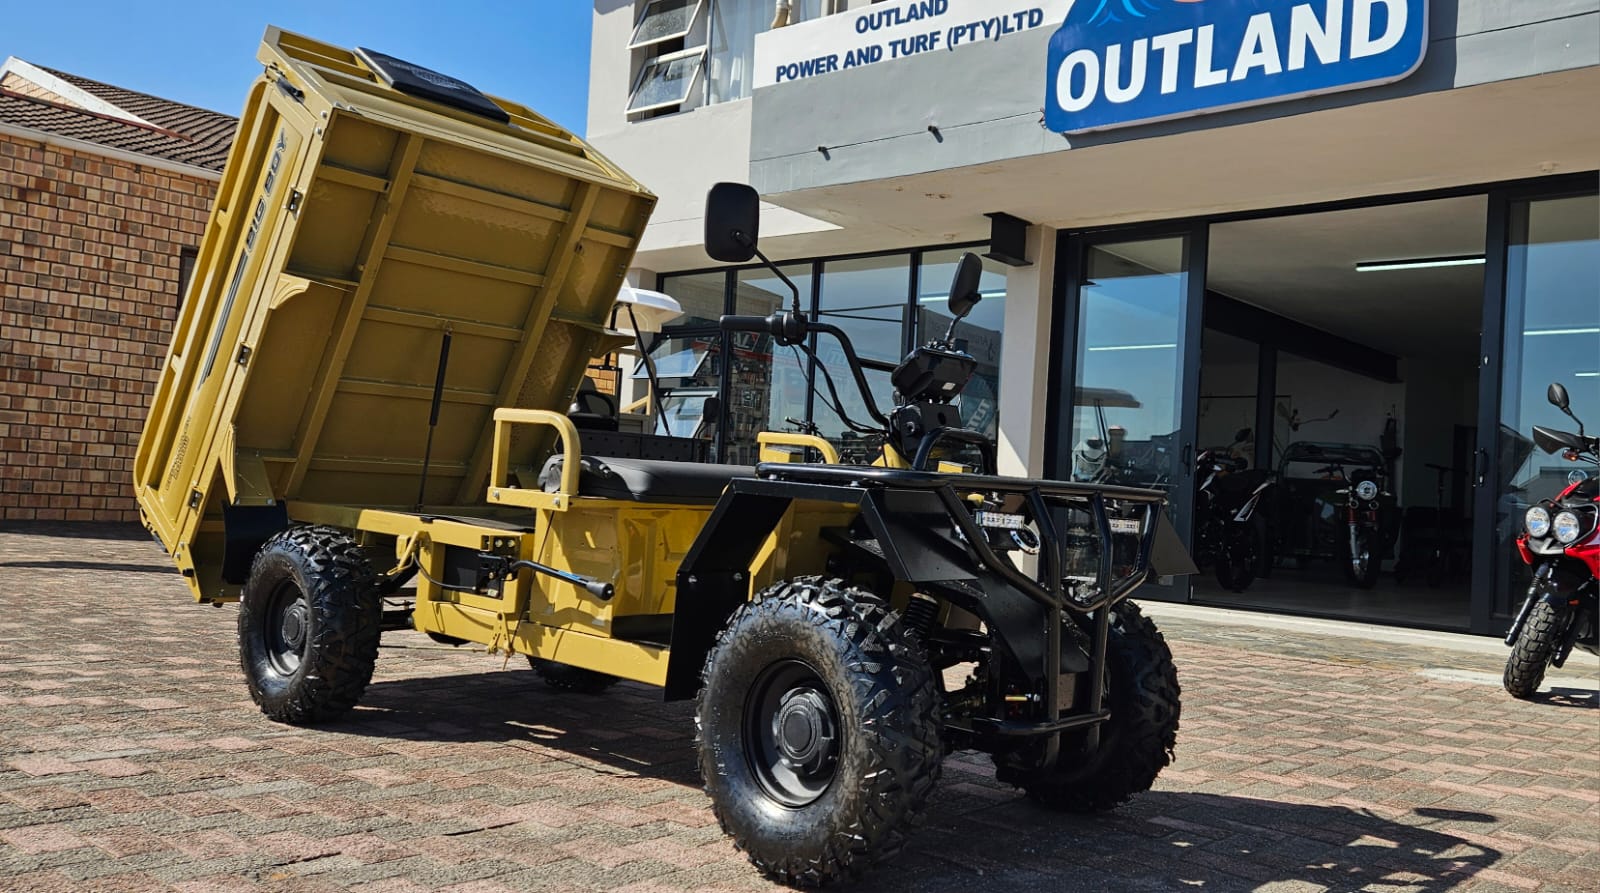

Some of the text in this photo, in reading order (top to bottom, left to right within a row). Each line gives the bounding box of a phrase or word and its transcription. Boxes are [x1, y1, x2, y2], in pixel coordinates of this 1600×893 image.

[776, 8, 1044, 82] POWER AND TURF (PTY)LTD
[856, 0, 949, 34] OUTLAND
[1056, 0, 1408, 112] OUTLAND
[246, 128, 286, 252] BIG BOY
